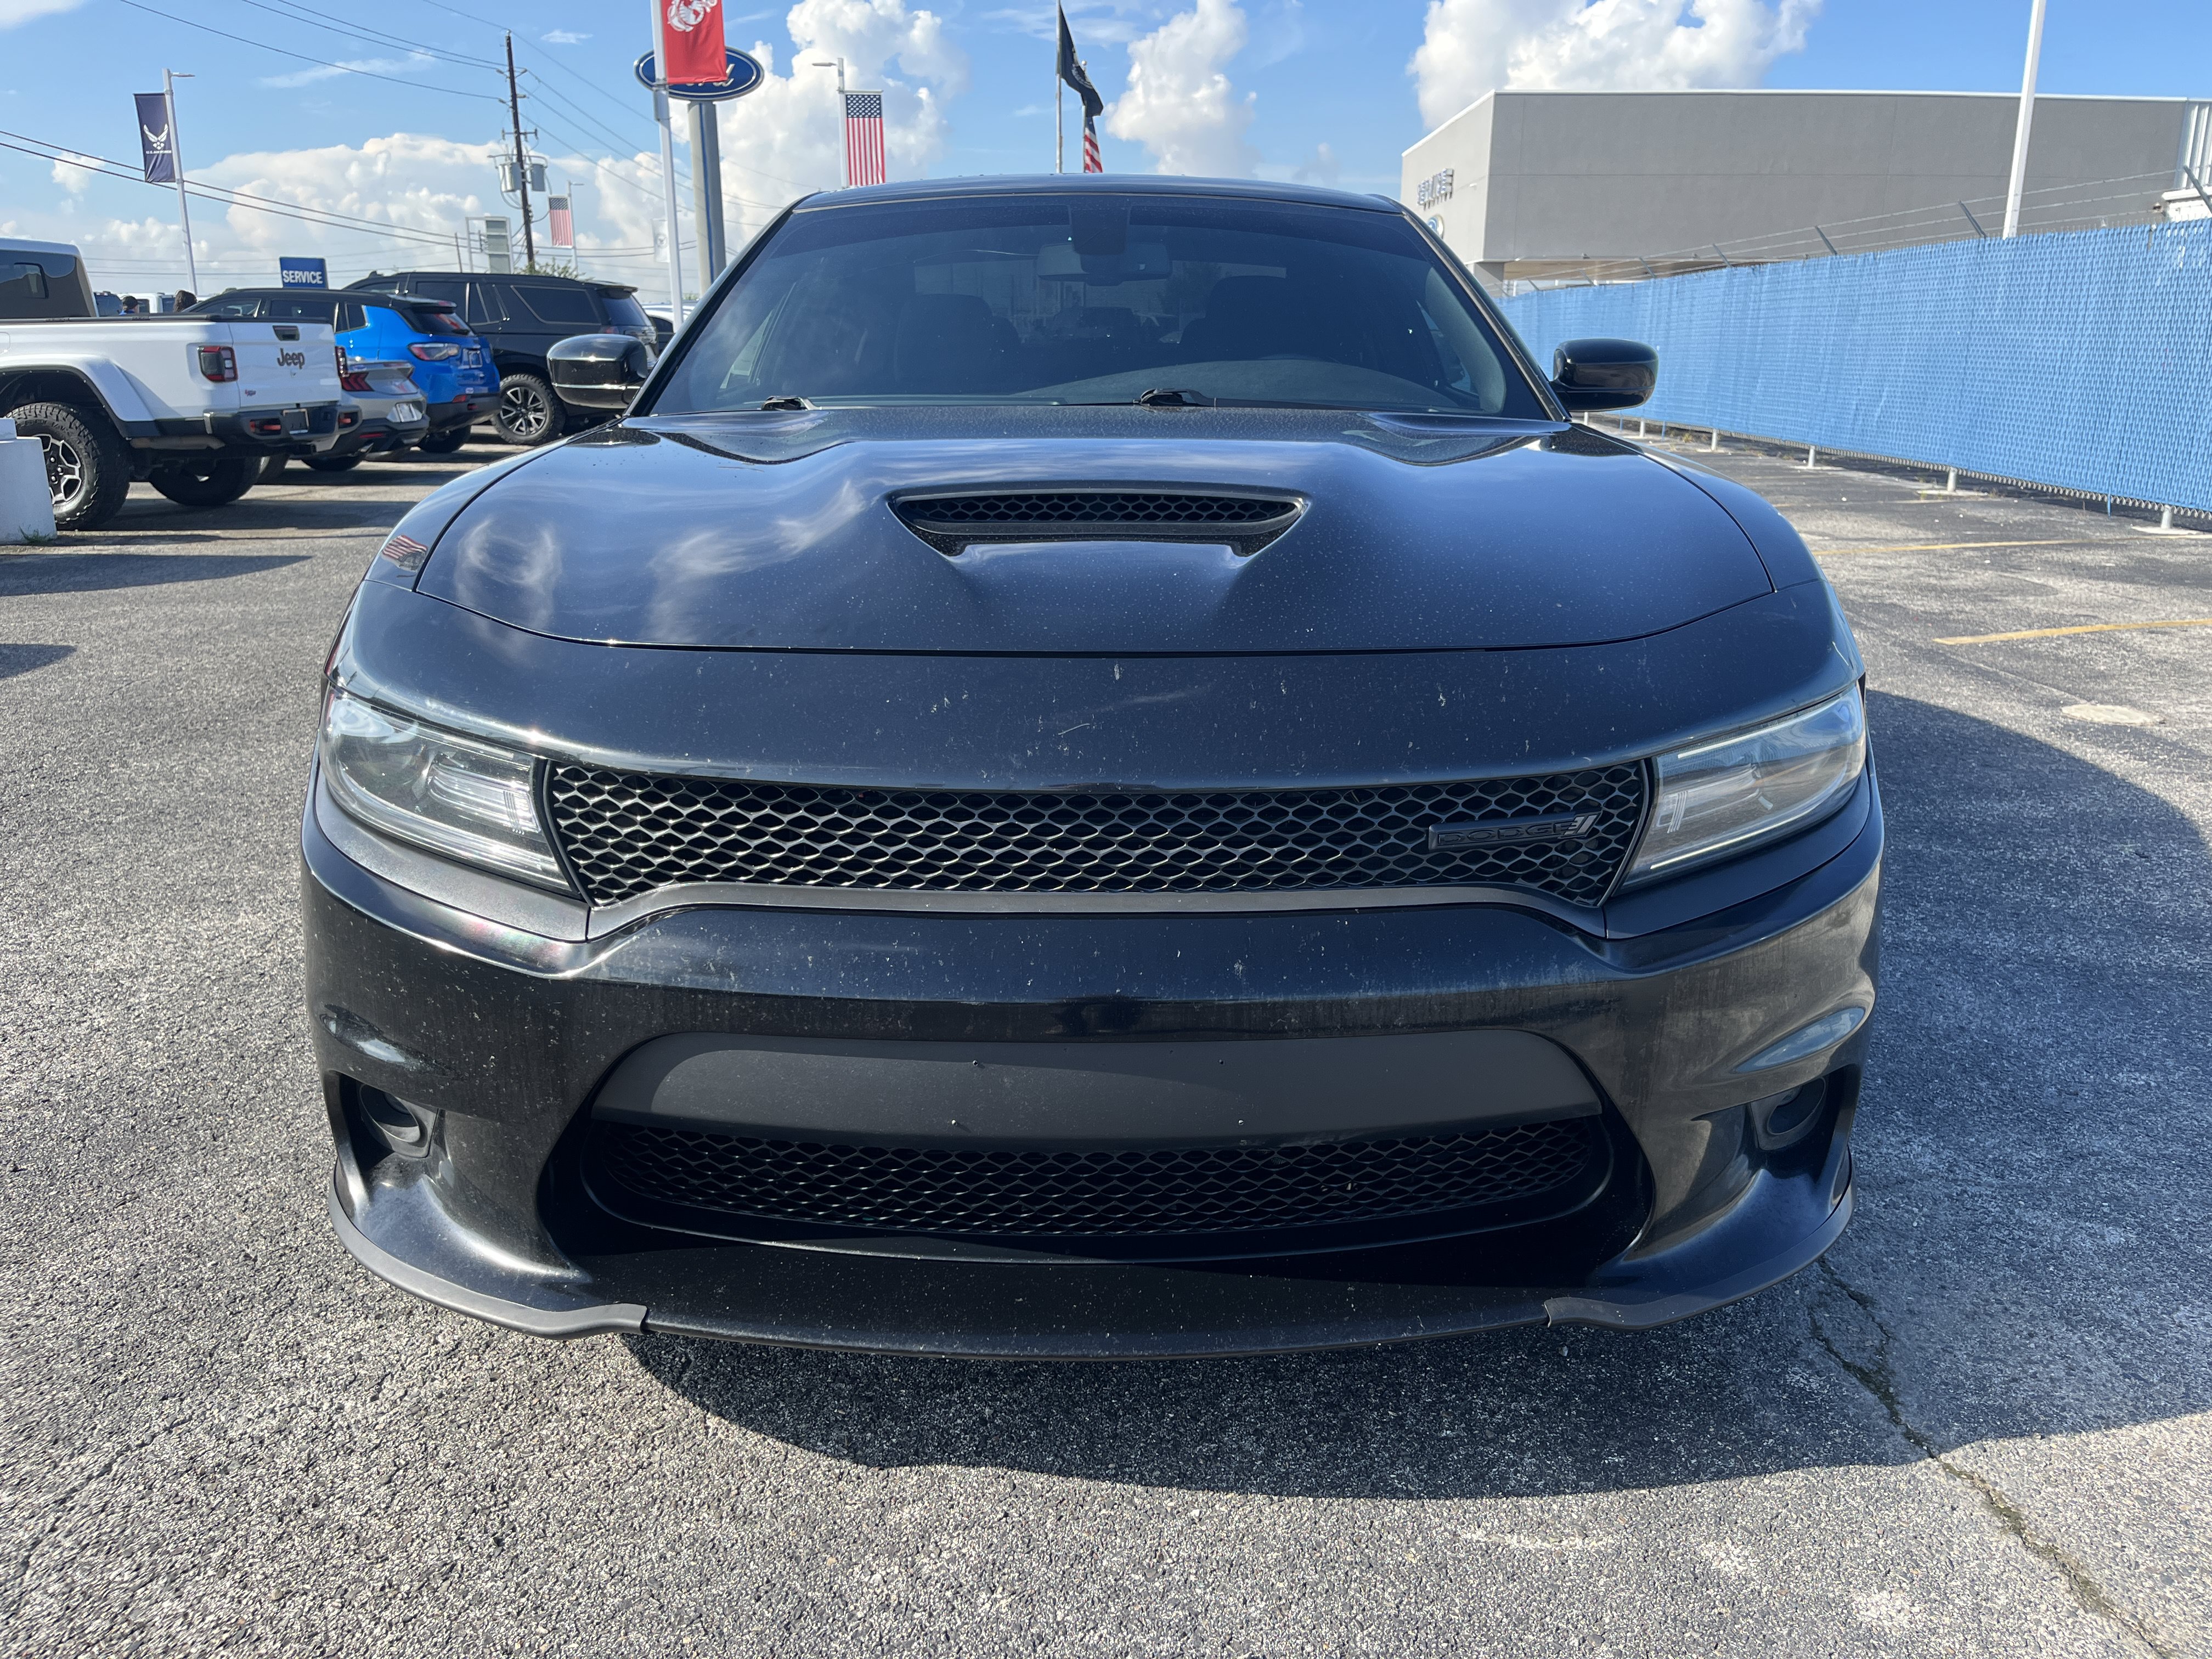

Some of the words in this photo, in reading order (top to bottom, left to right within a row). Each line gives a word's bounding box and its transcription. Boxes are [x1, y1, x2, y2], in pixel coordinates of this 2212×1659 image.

[282, 270, 323, 284] SERVICE
[276, 347, 305, 369] Jeep
[1437, 820, 1578, 845] DODGE
